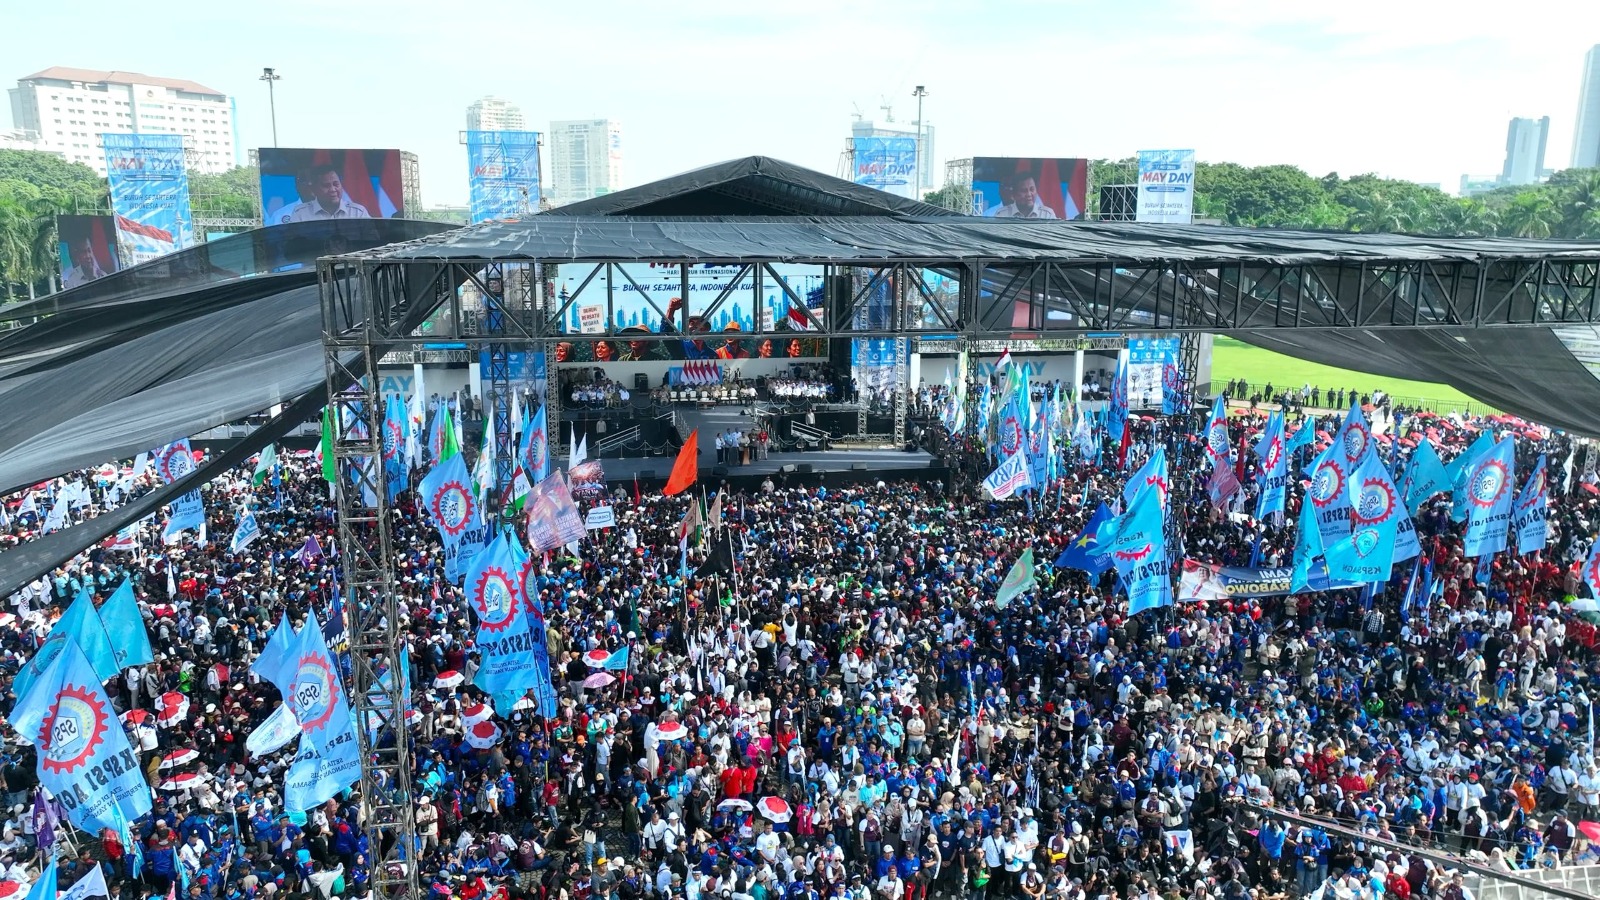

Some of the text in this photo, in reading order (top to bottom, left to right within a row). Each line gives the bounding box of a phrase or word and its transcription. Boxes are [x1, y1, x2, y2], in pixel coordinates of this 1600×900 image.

[858, 163, 913, 176] MAY DAY
[1142, 172, 1193, 184] MAY DAY
[653, 283, 698, 293] SEJAHTRA,
